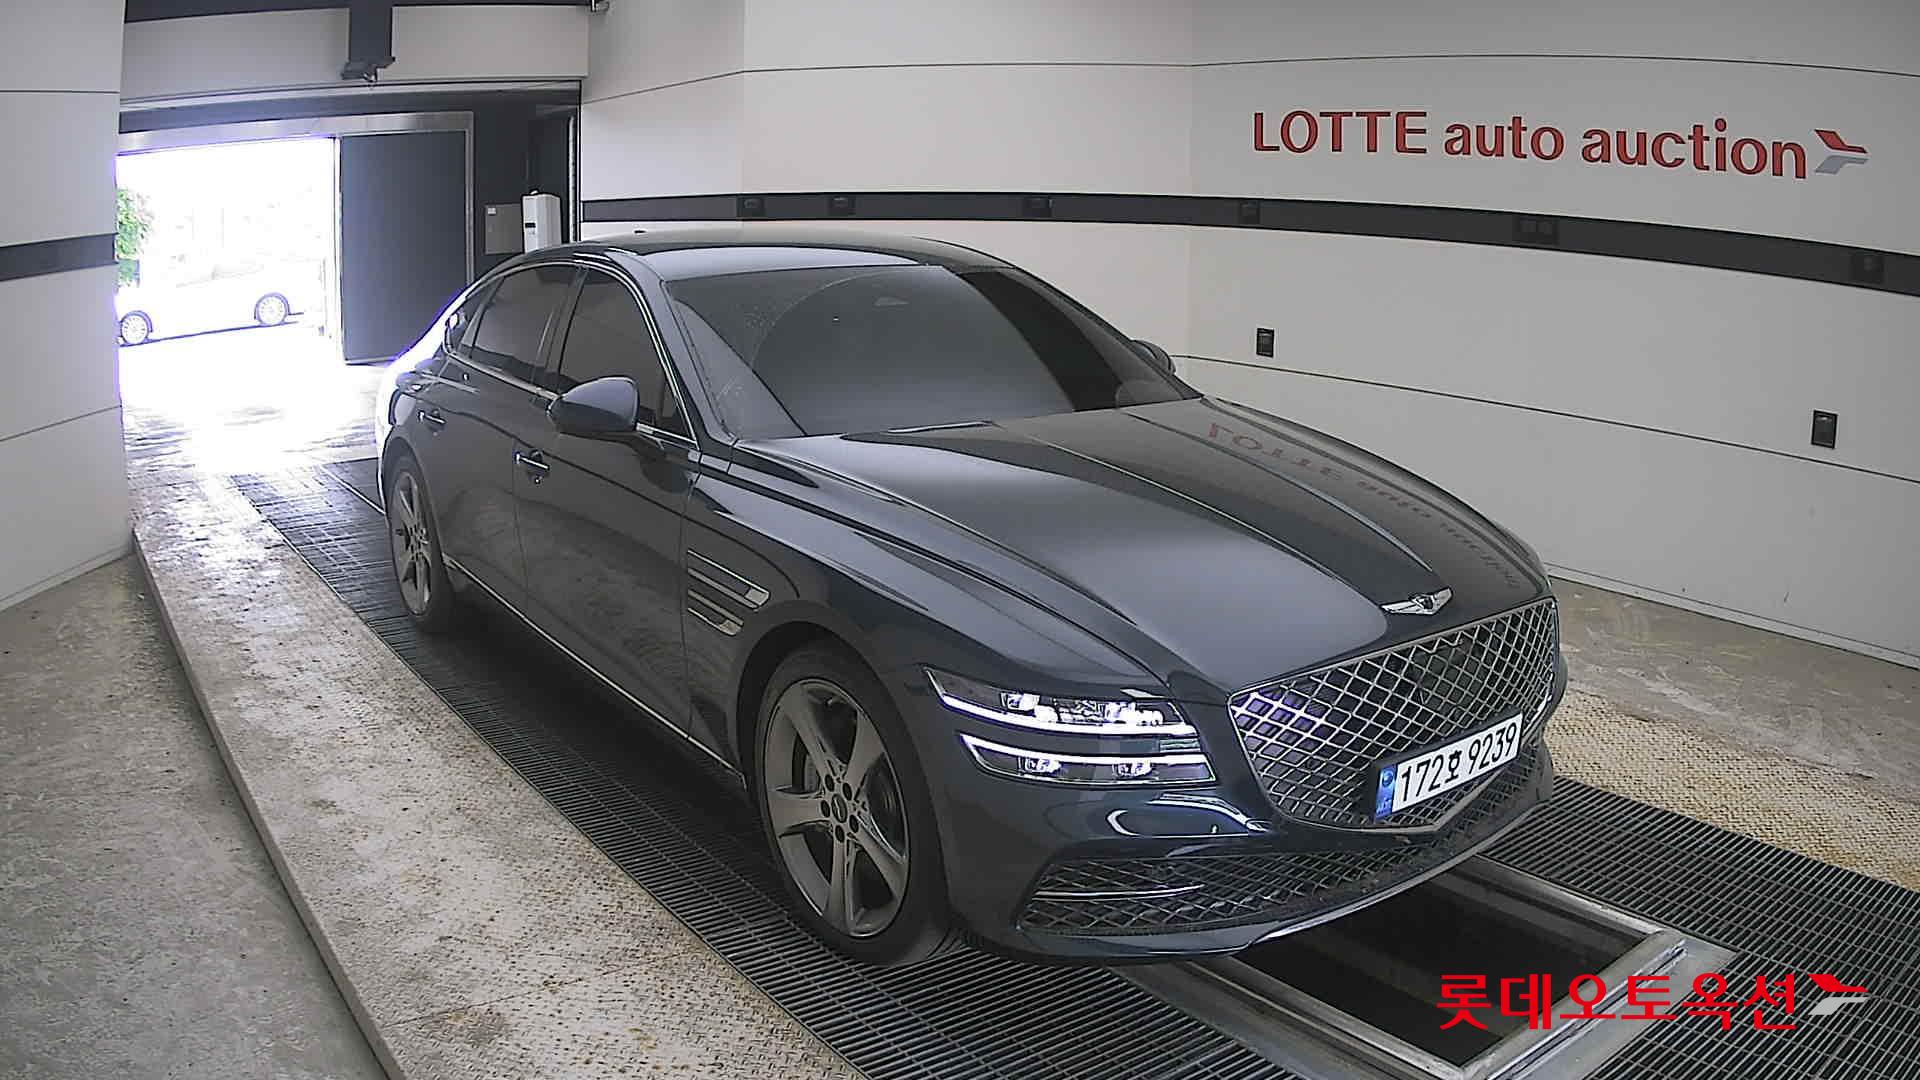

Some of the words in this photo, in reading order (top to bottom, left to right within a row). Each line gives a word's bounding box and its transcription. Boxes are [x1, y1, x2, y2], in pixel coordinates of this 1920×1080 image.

[1254, 110, 1426, 154] LOTTE
[1445, 116, 1565, 161] auto
[1581, 118, 1808, 179] auction
[1400, 749, 1463, 802] 172호
[1468, 722, 1518, 775] 9239
